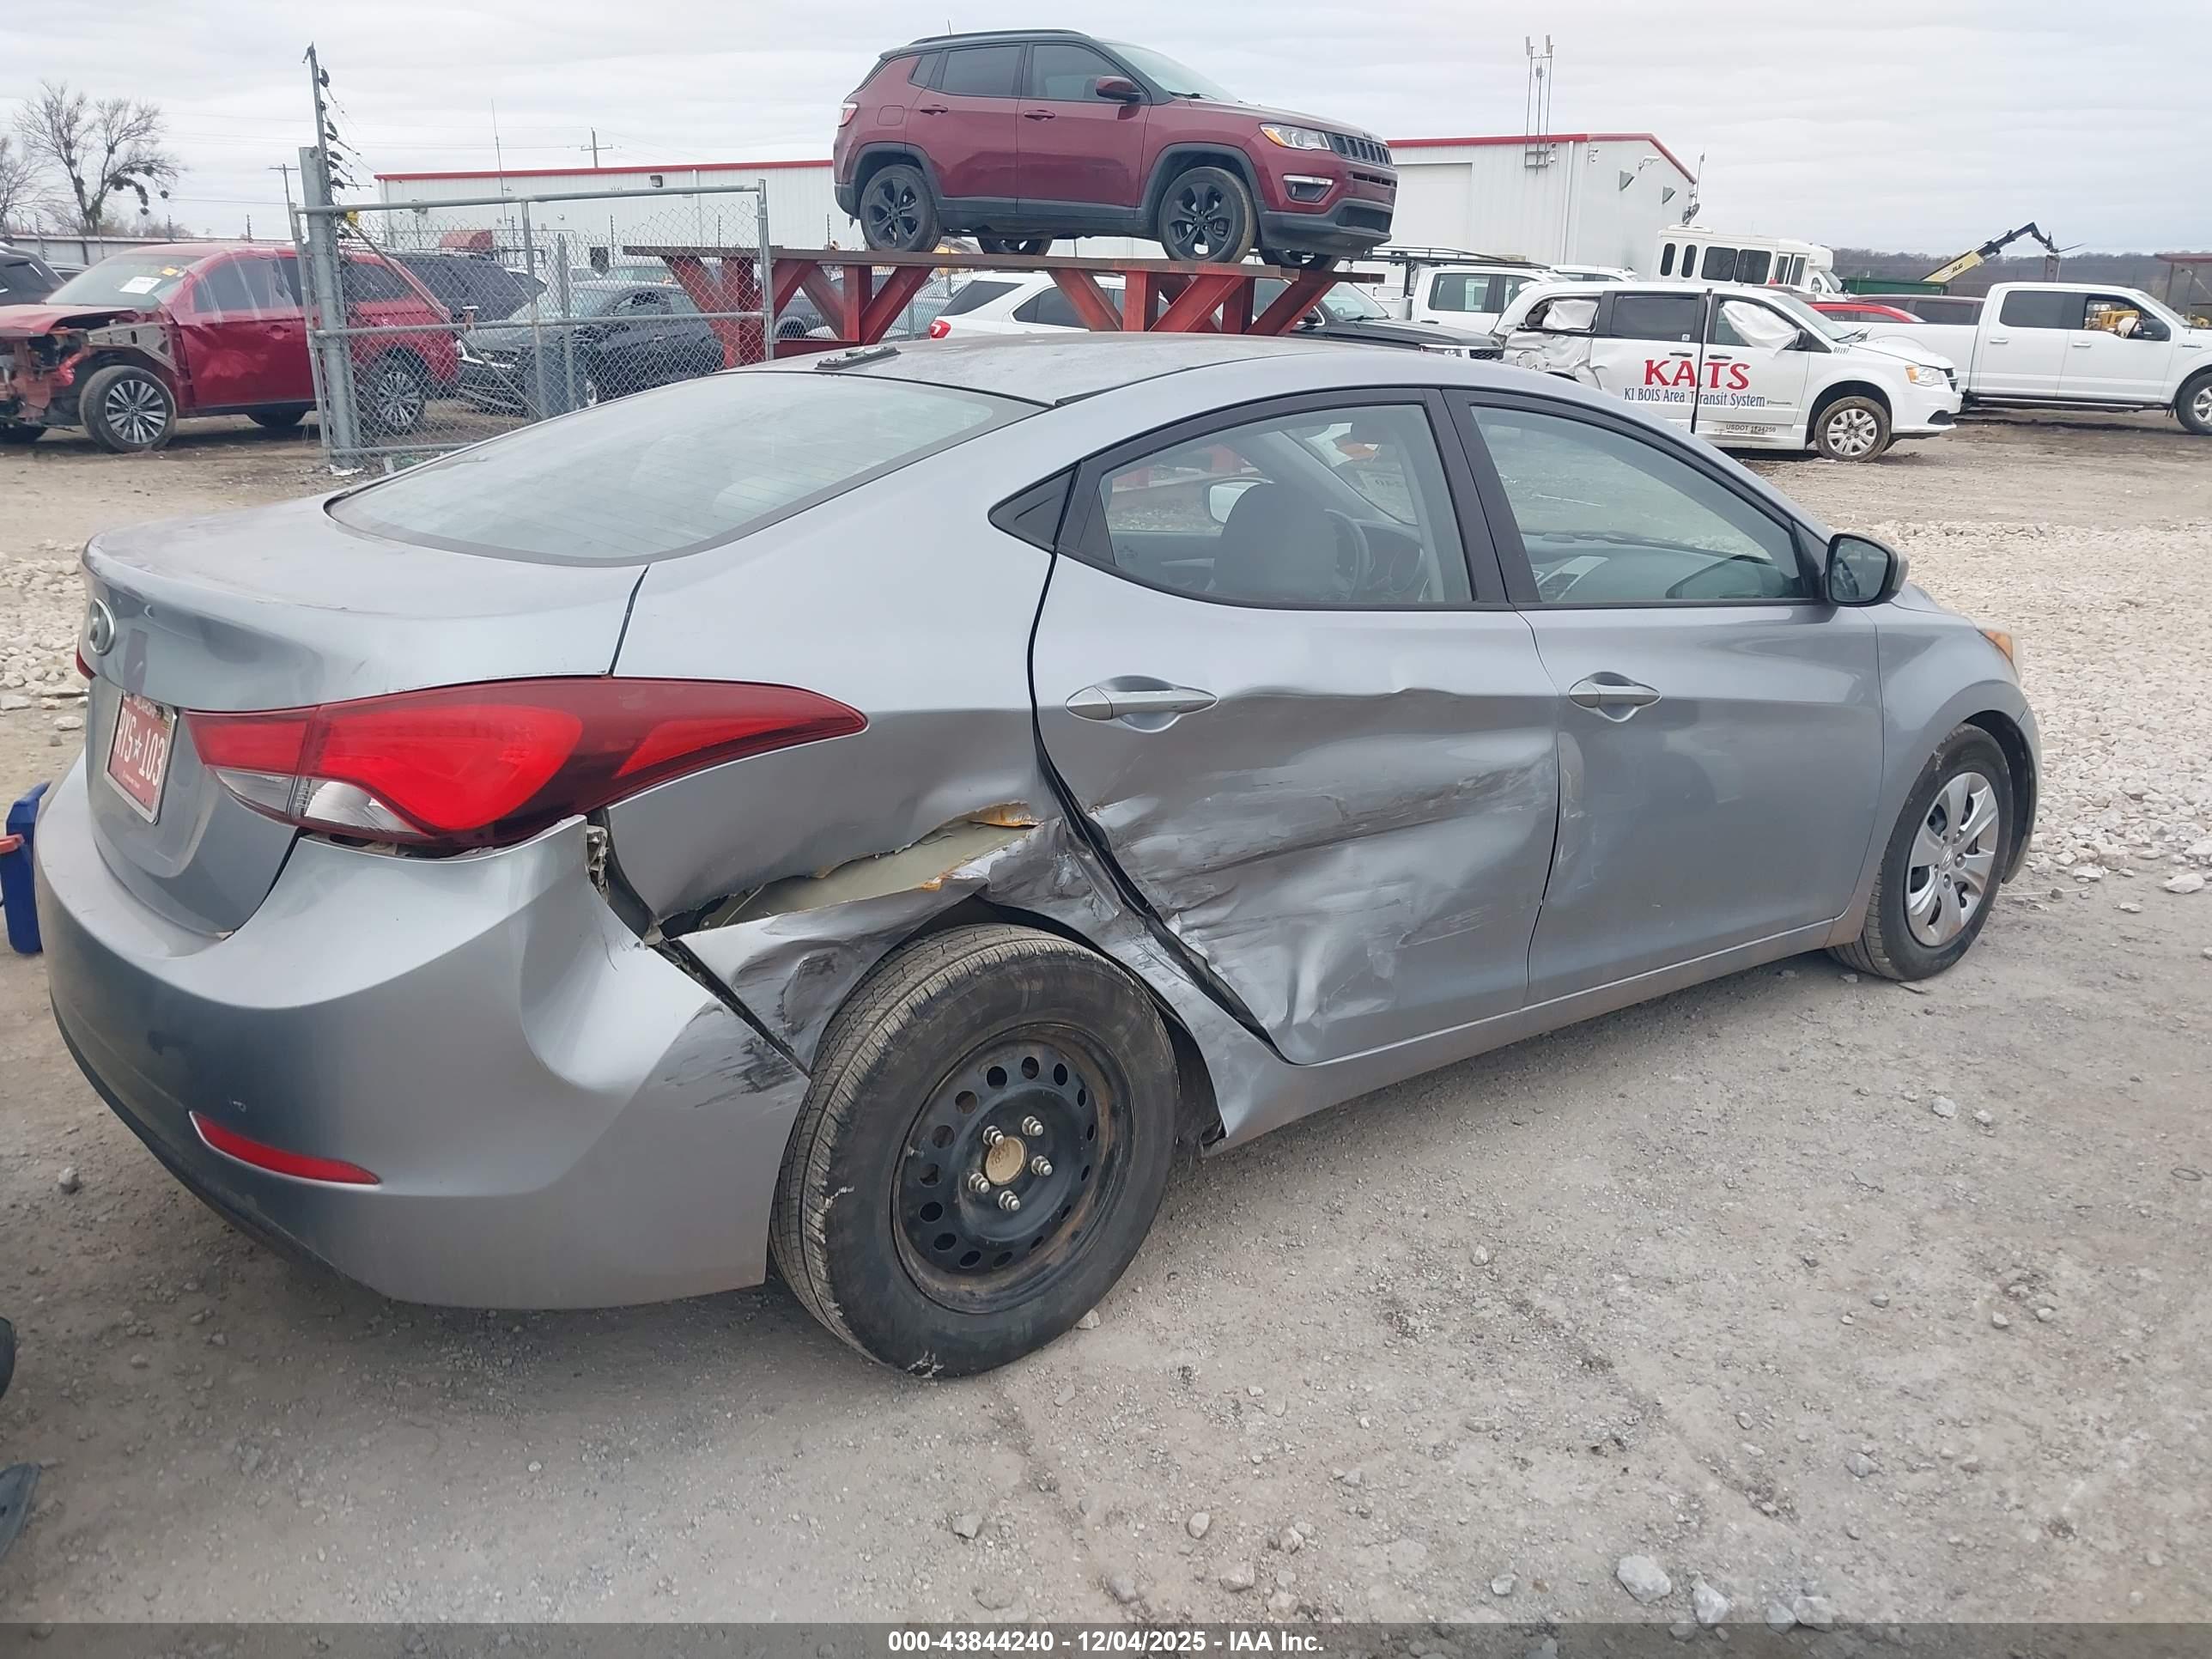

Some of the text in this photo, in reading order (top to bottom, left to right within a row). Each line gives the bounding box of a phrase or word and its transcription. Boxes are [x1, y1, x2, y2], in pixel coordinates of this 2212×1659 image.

[1950, 262, 1964, 273] JLG
[1644, 359, 1752, 390] KATS
[1624, 387, 1634, 400] KI
[1638, 388, 1661, 402] BOIS
[1662, 389, 1685, 403] Area
[1690, 391, 1728, 406] Transit
[1729, 392, 1765, 410] System
[138, 727, 167, 787] 103
